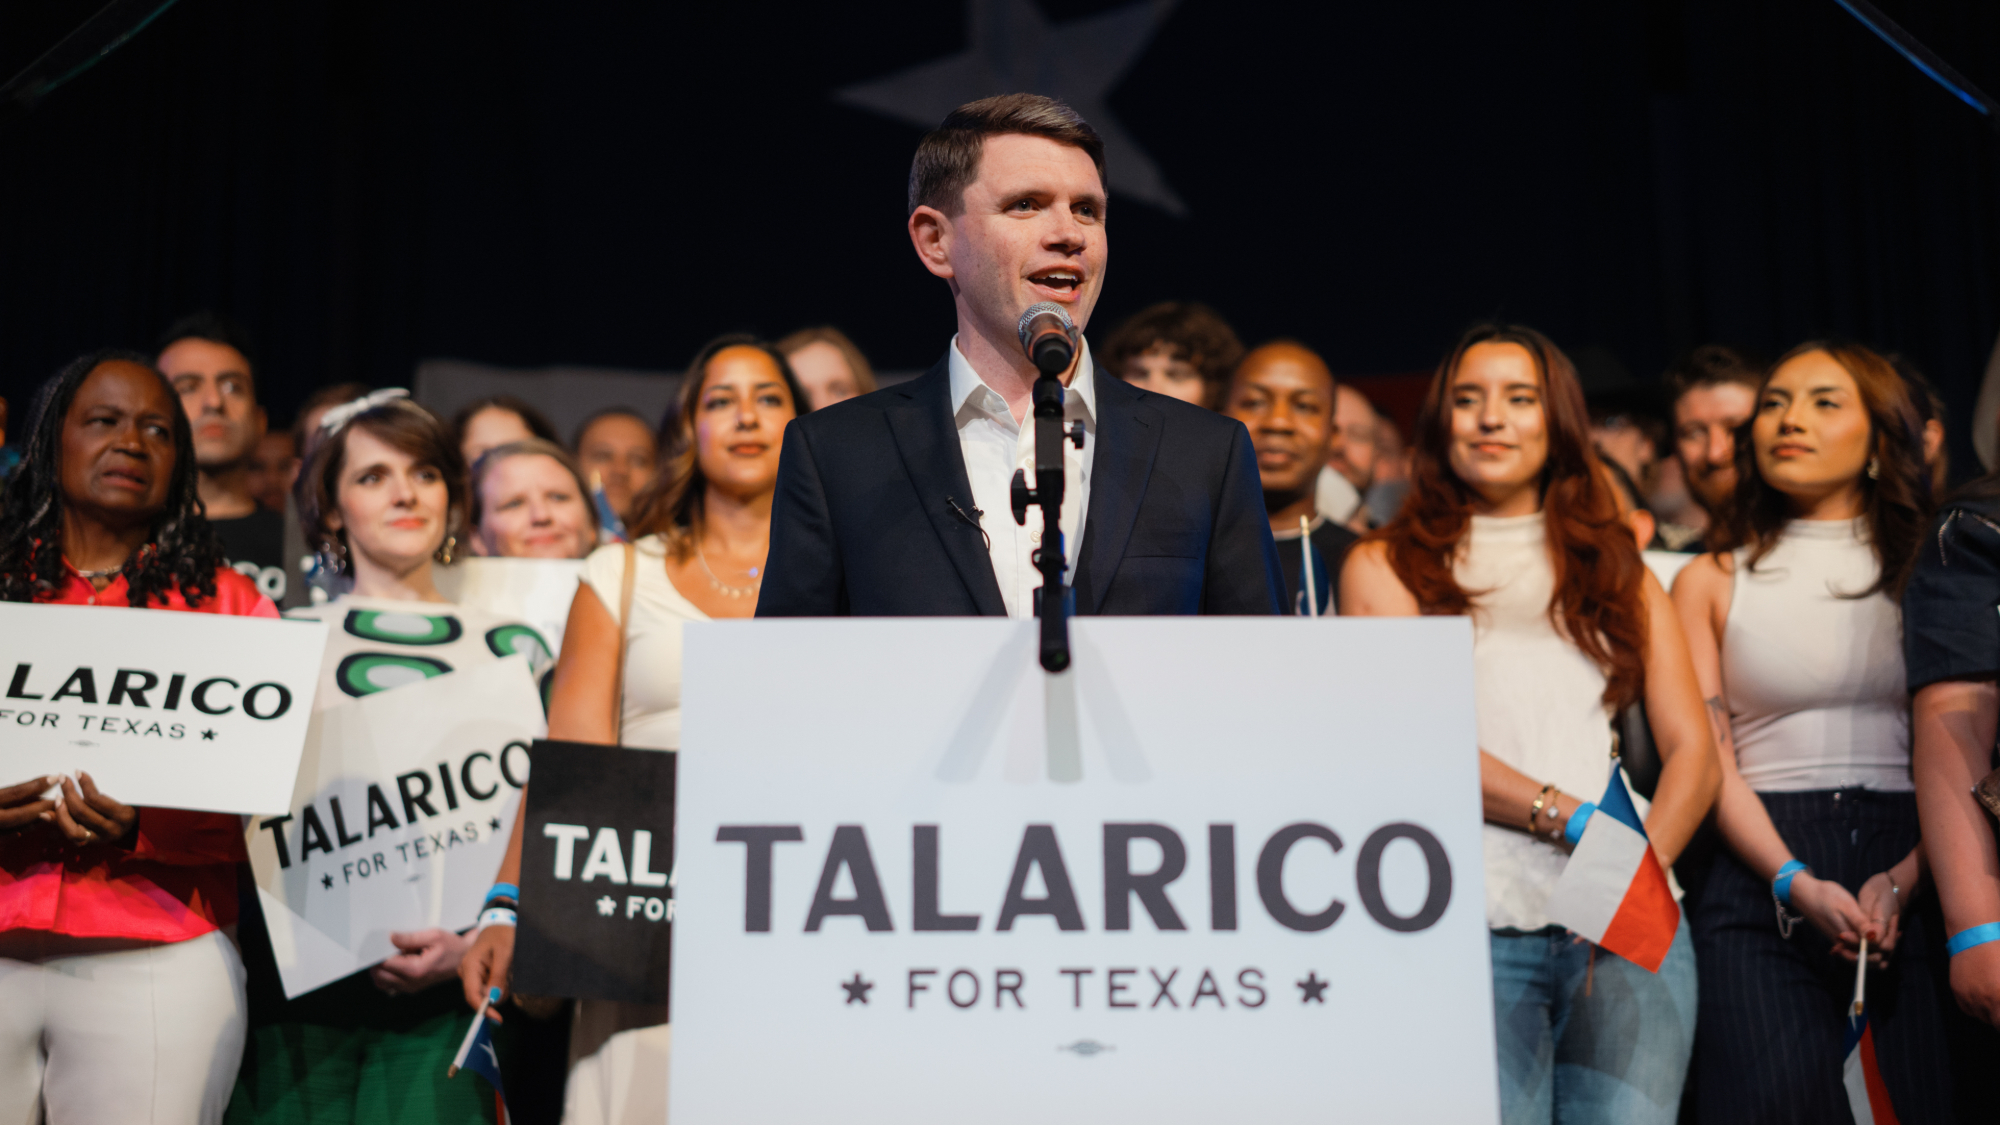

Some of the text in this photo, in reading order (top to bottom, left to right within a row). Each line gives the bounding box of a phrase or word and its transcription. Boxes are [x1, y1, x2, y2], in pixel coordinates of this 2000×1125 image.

[5, 662, 293, 721] LARICO
[78, 713, 187, 740] TEXAS
[259, 740, 531, 870] TALARICO
[341, 819, 479, 884] FOR TEXAS
[542, 822, 678, 889] TAL
[714, 821, 1455, 936] TALARICO
[906, 967, 1269, 1010] FOR TEXAS
